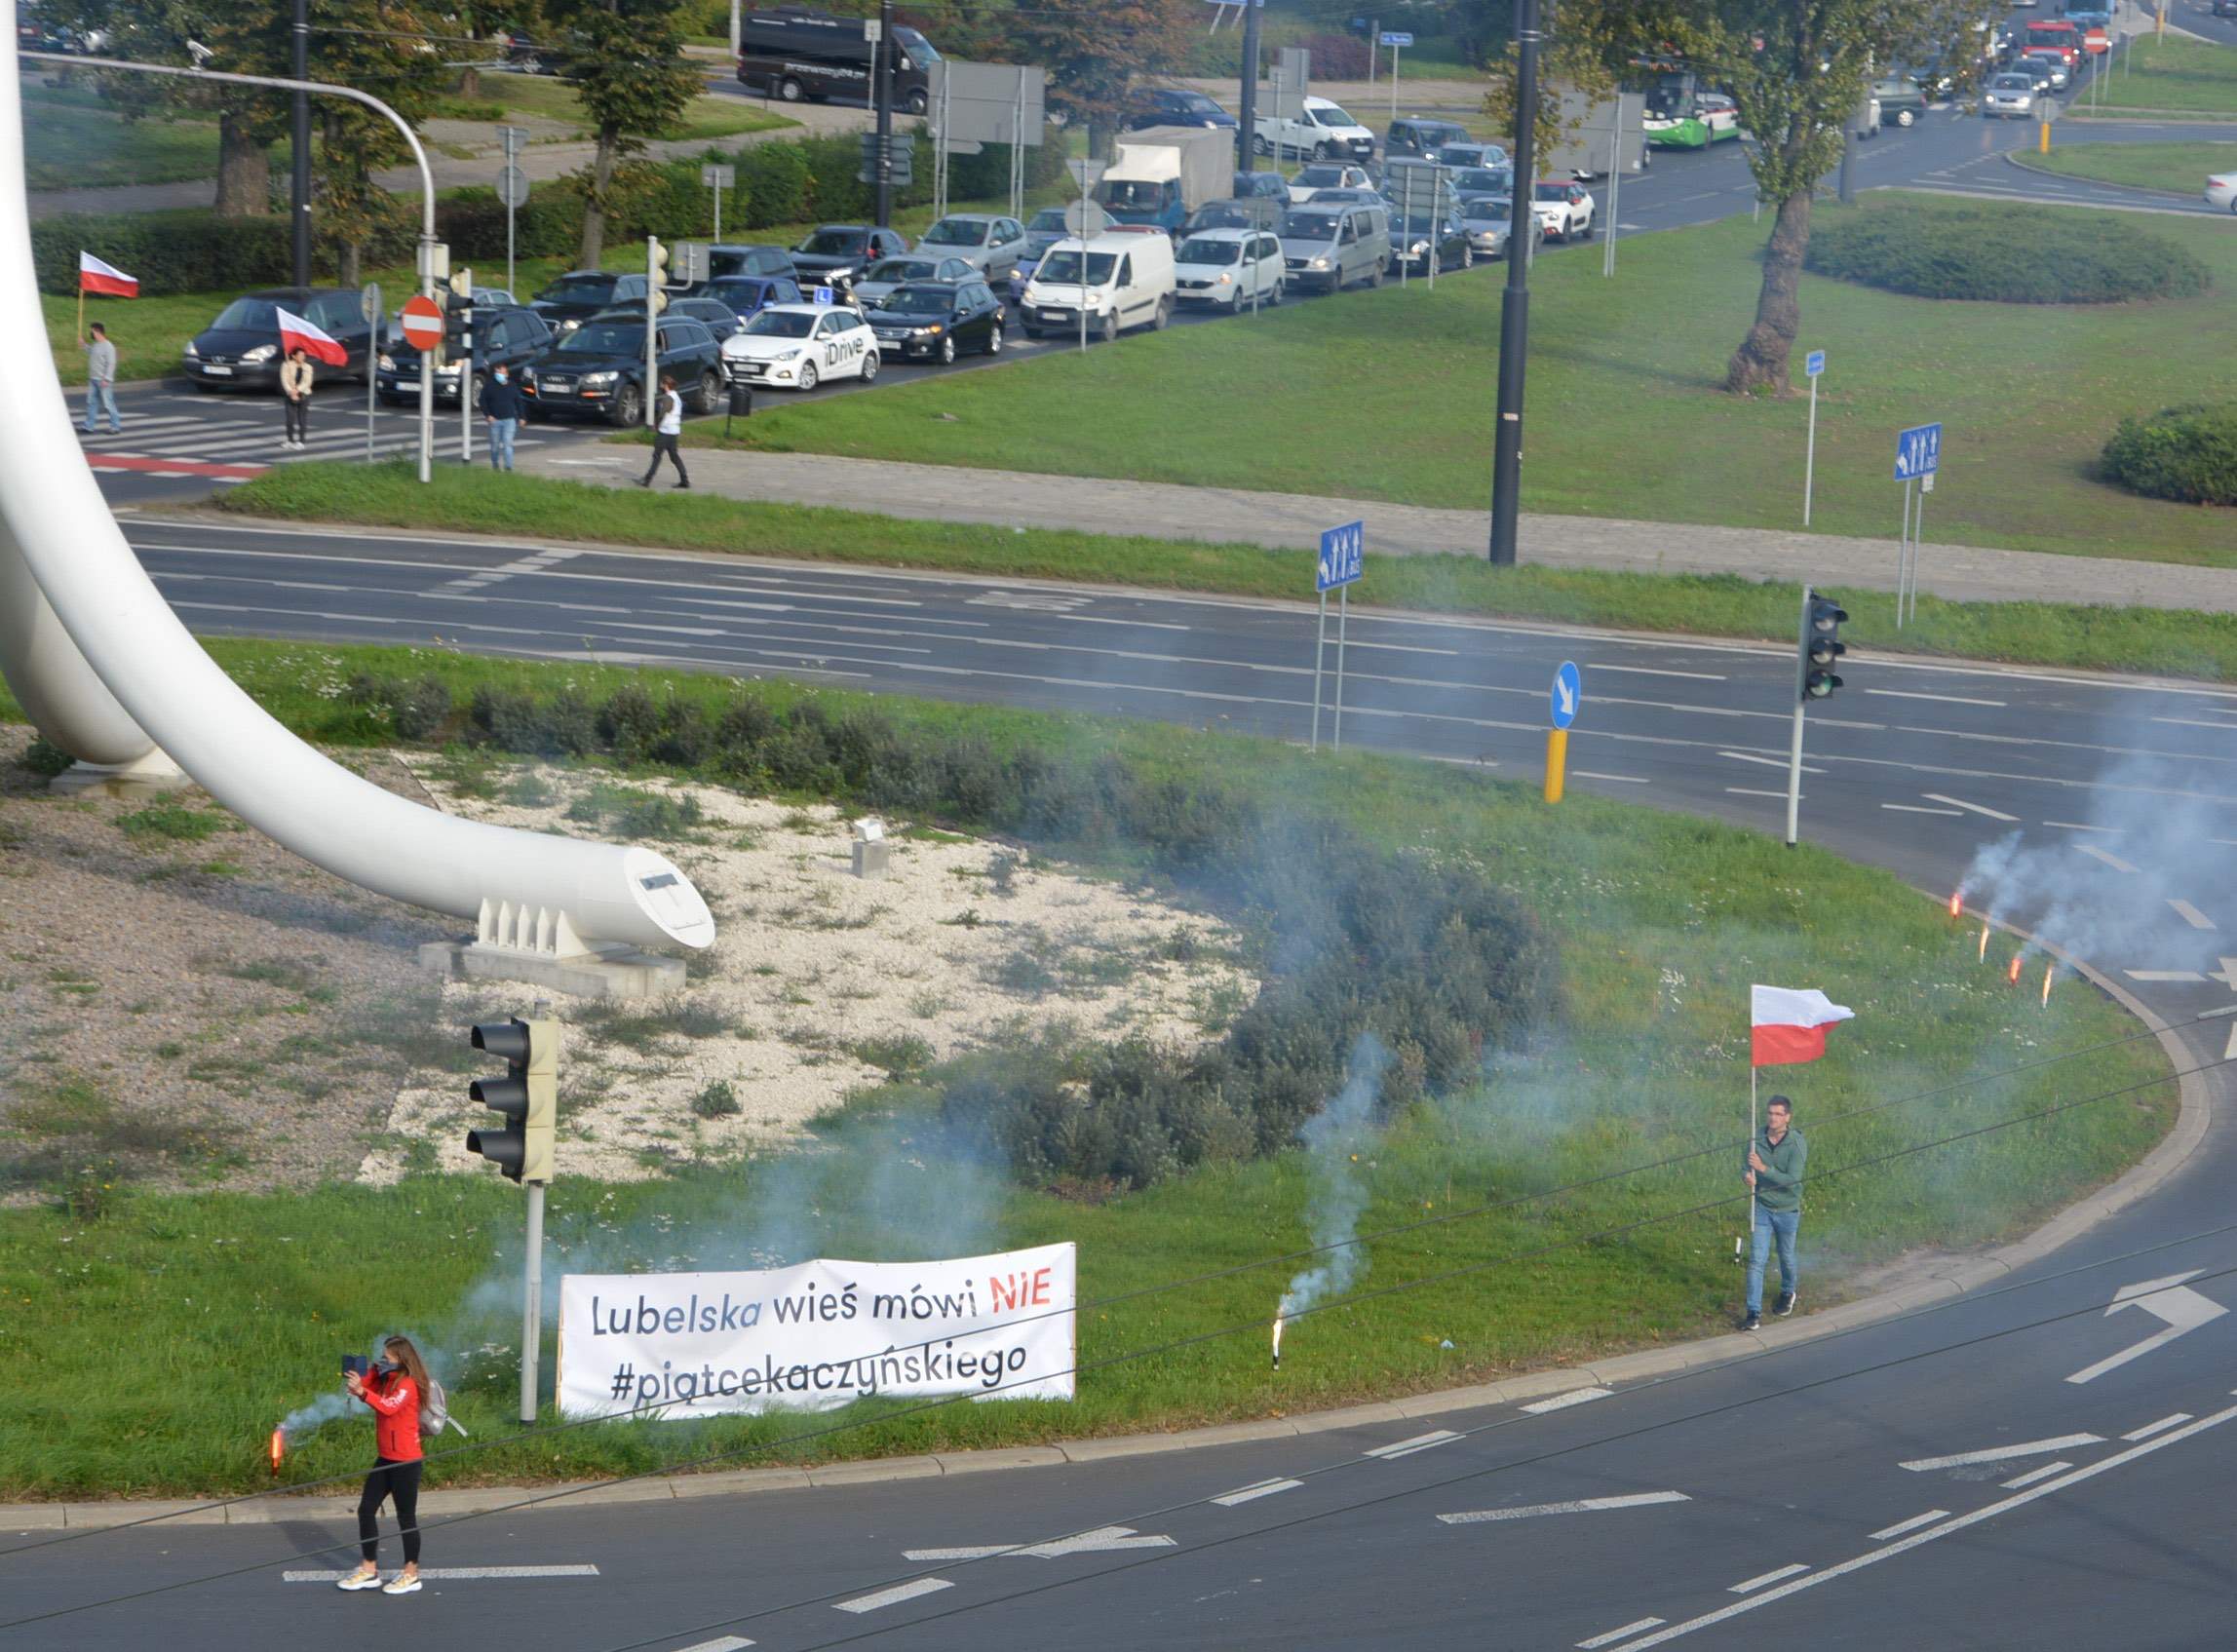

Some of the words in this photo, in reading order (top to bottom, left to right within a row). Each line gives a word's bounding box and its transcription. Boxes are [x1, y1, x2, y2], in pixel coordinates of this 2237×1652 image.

[825, 337, 864, 367] iDrive
[1349, 558, 1361, 576] BUS
[593, 1293, 762, 1335] Lubelska
[773, 1282, 858, 1324] wieś
[872, 1279, 977, 1320] mówi
[989, 1267, 1051, 1314] NIE
[611, 1340, 1026, 1408] #piątcekaczyńskiego
